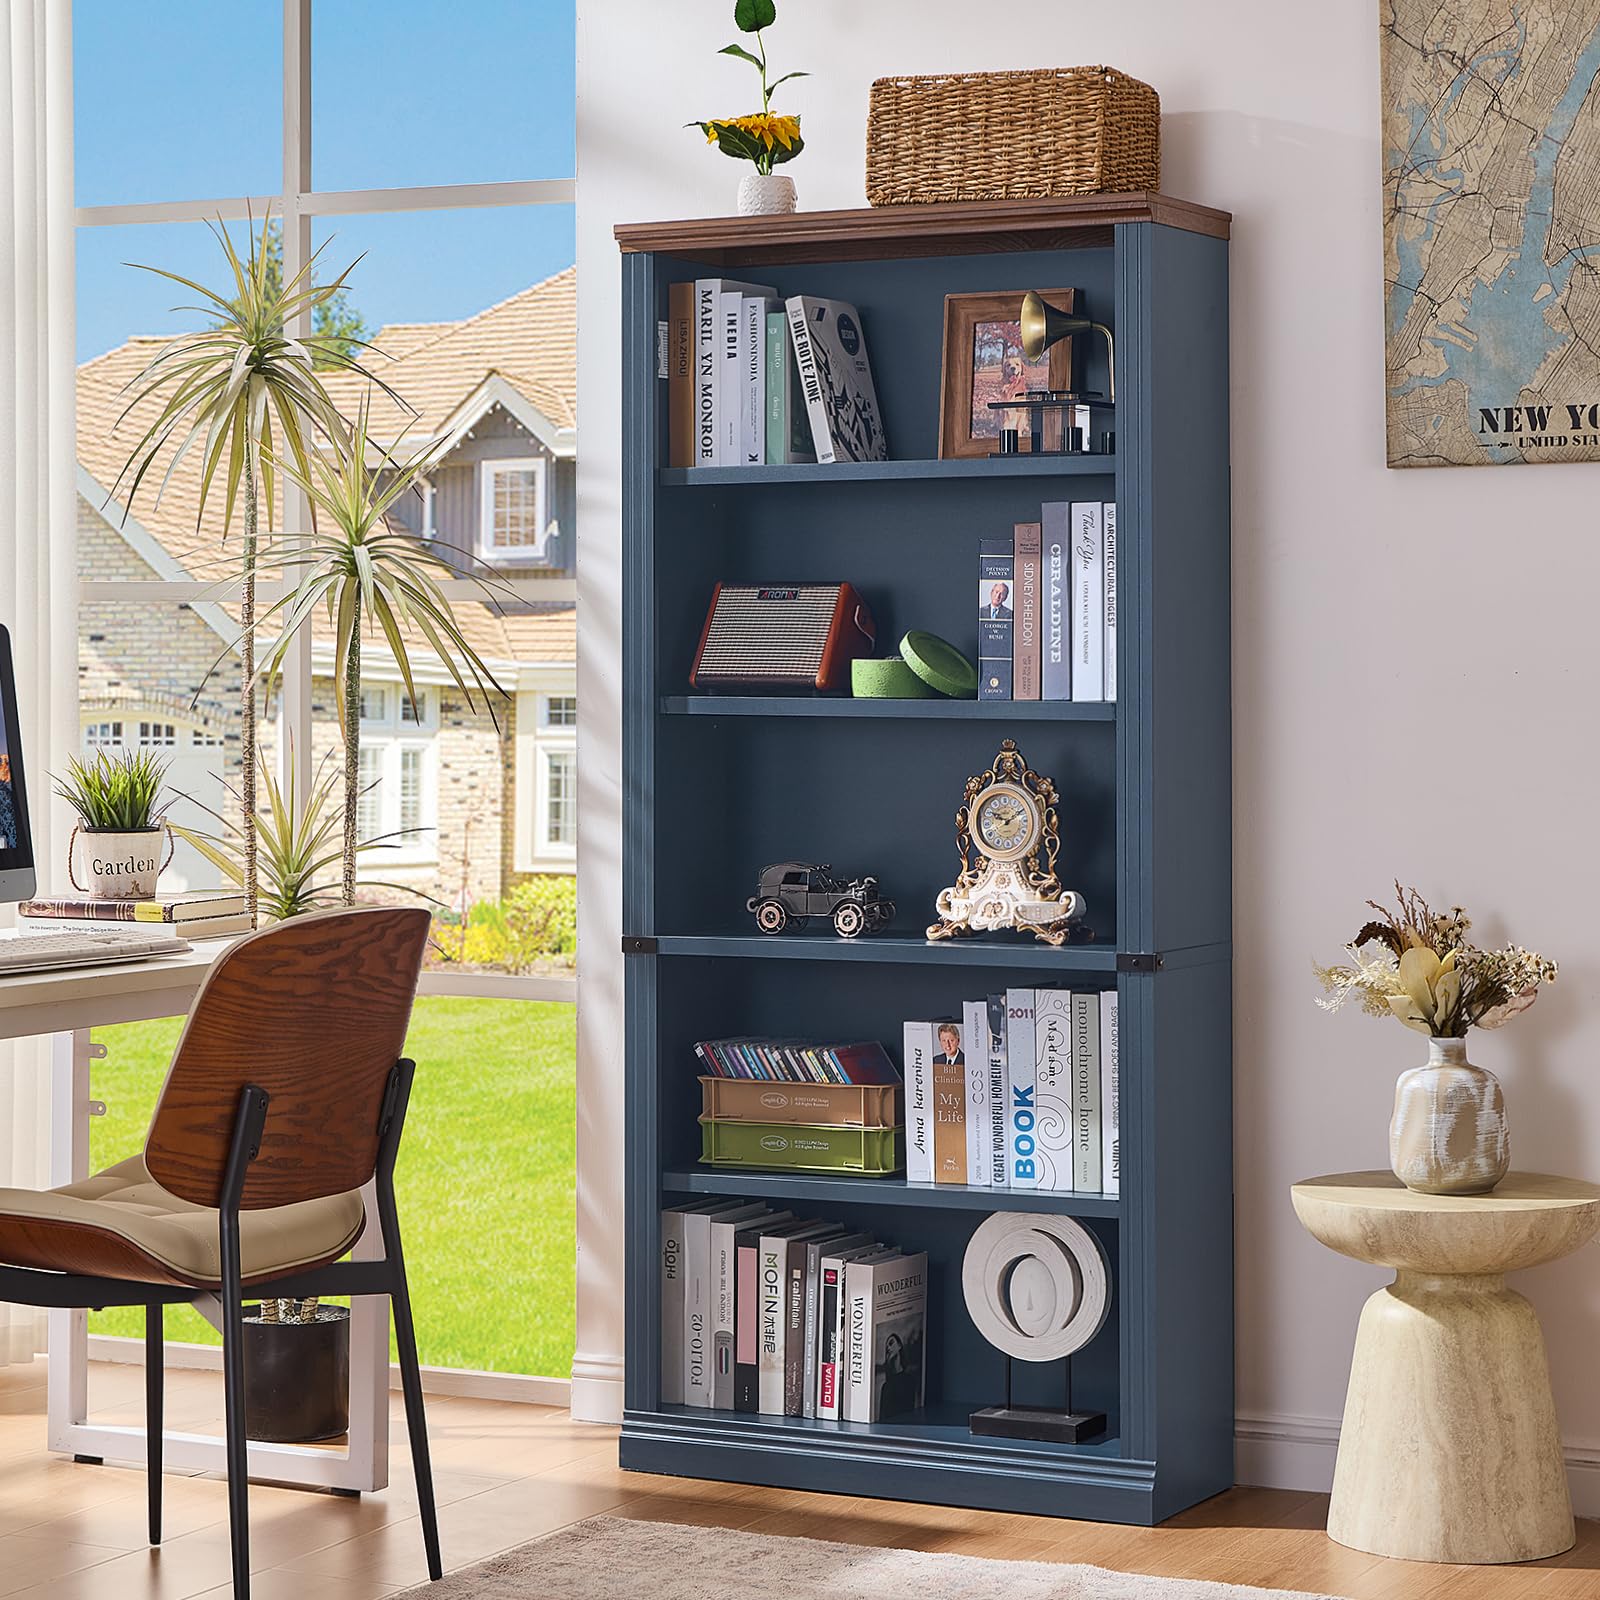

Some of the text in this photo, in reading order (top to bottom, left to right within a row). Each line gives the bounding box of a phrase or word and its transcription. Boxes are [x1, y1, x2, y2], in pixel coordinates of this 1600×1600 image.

[750, 305, 758, 381] FASHIONINDIA
[792, 320, 807, 340] DIE
[680, 346, 688, 374] ZHOU
[701, 290, 713, 458] MARIL YN MONROE
[797, 341, 814, 372] ROTE
[804, 372, 821, 404] ZONE
[1478, 406, 1553, 434] NEW
[748, 454, 758, 462] K
[1518, 435, 1568, 448] UNITED
[1076, 510, 1095, 570] Thank You
[1107, 523, 1115, 594] ARCHITECTURAL
[1023, 562, 1034, 647] SIDNEY SHELDON
[1107, 597, 1115, 628] DIGEST
[92, 856, 155, 876] Garden
[1009, 1007, 1034, 1019] 2011
[1048, 1020, 1057, 1087] Madame
[971, 1070, 984, 1105] COS
[1078, 1000, 1093, 1152] monochrome home
[912, 1048, 925, 1154] Anna karenina
[938, 1110, 963, 1123] Life
[940, 1093, 961, 1109] My
[990, 1059, 1005, 1183] CREATE WONDERFUL HOMELIFE
[1013, 1084, 1036, 1180] BOOK
[666, 1239, 676, 1279] PHOTO
[877, 1274, 923, 1297] WONDERFUL
[791, 1281, 801, 1329] callaitalia
[691, 1314, 703, 1386] FOLIO-02
[852, 1297, 864, 1388] WONDERFUL
[824, 1367, 832, 1403] OLIVIA
